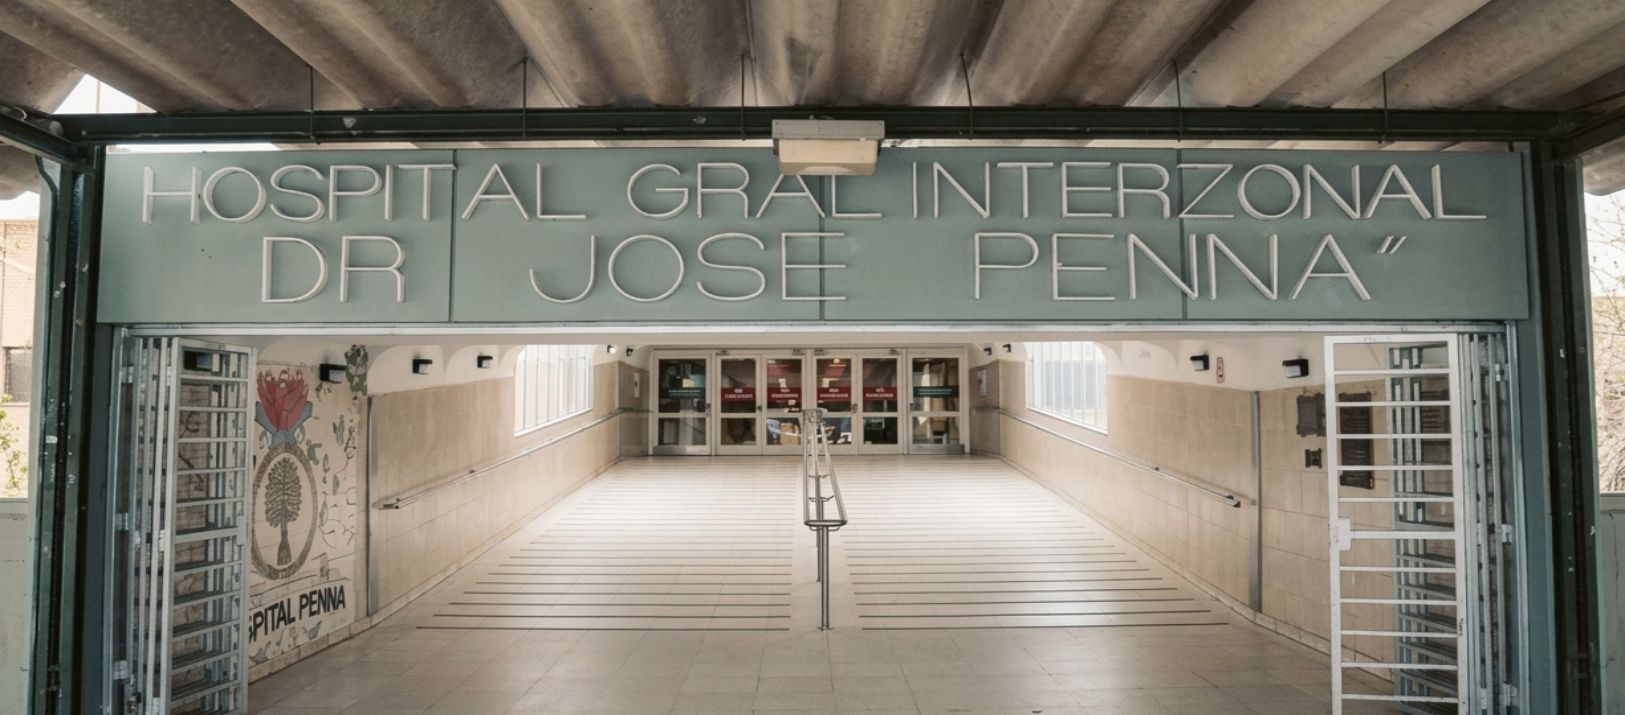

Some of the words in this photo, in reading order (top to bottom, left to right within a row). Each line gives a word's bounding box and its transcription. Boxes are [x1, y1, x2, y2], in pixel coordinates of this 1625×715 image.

[141, 163, 587, 224] HOSPITAL
[627, 161, 882, 222] GRAL
[912, 161, 1487, 221] INTERZONAL
[261, 235, 405, 304] DR
[529, 232, 847, 303] JOSE
[299, 585, 346, 620] PENNA
